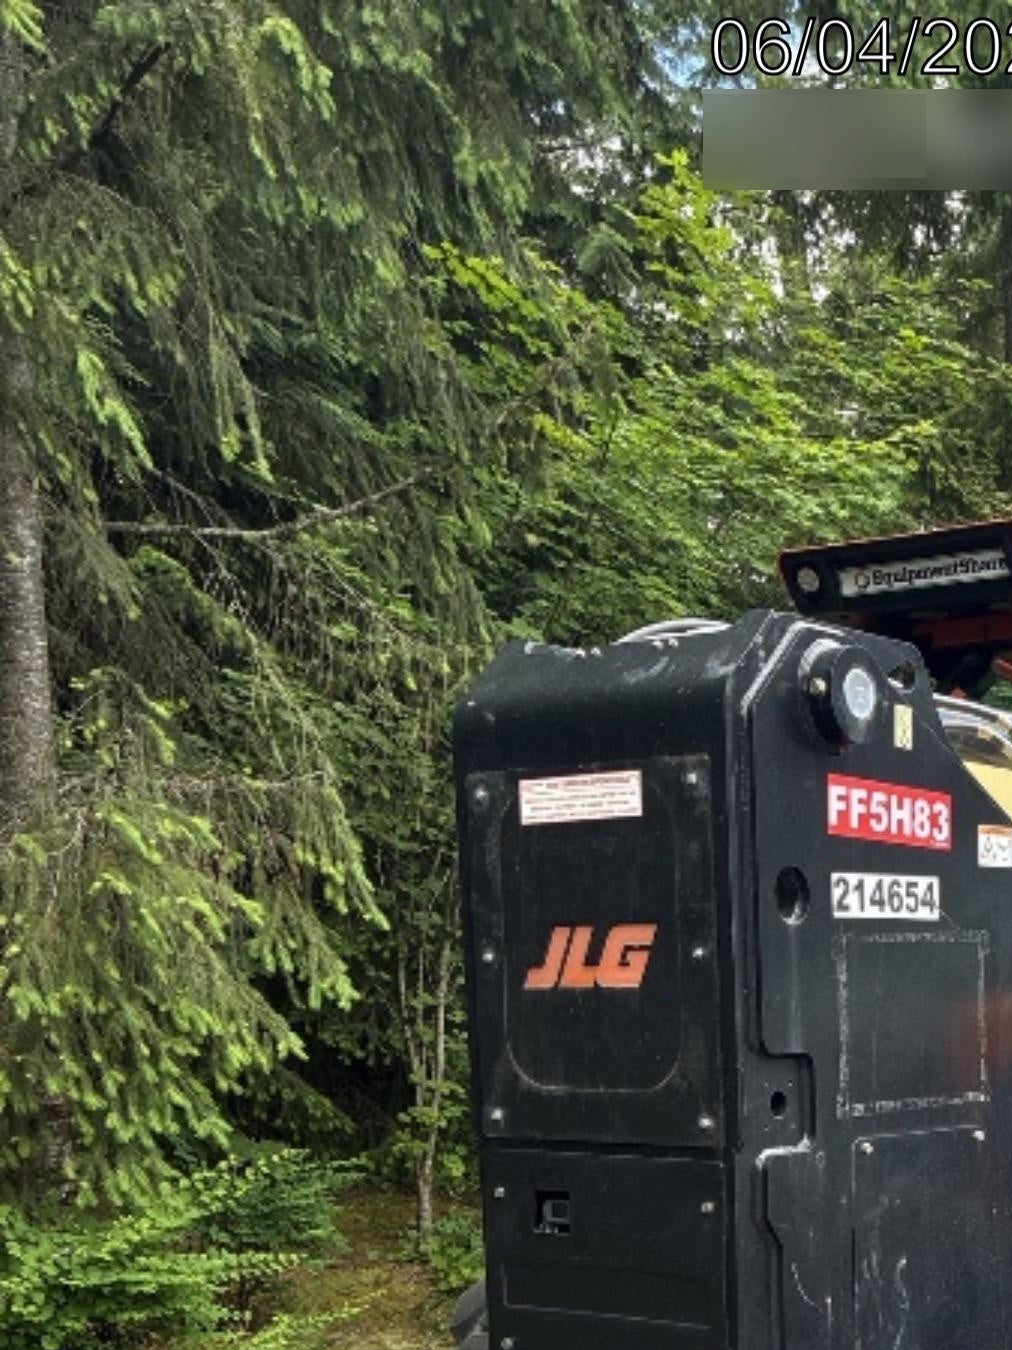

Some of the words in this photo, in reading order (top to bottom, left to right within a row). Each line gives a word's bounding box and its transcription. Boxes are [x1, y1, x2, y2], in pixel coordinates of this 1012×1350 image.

[827, 784, 950, 842] FF5H83
[834, 876, 938, 914] 214654
[523, 922, 657, 990] JLG
